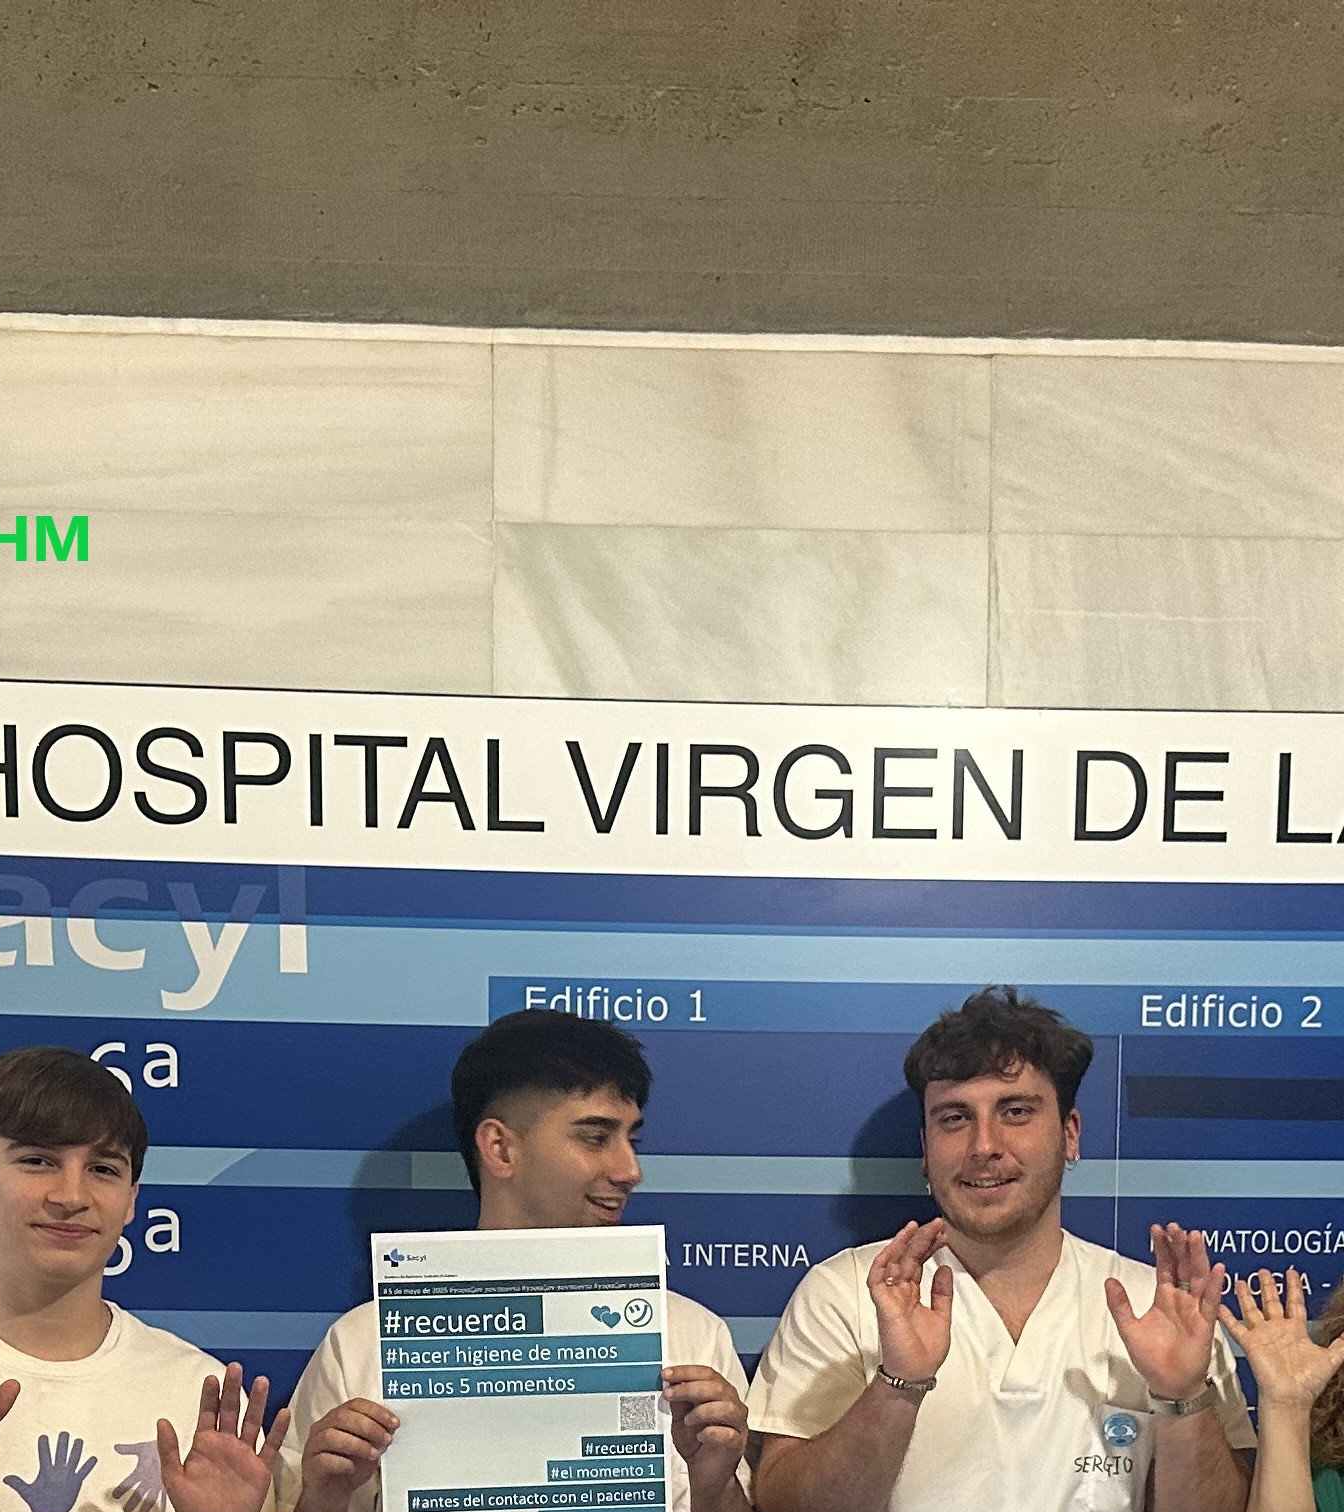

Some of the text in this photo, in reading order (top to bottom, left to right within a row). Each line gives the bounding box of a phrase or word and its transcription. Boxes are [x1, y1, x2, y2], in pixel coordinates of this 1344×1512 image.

[566, 737, 1025, 842] VIRGEN
[1073, 749, 1229, 844] DE
[525, 986, 707, 1021] Edificio 1
[1140, 993, 1322, 1028] Edificio 2
[683, 1244, 810, 1267] INTERNA
[384, 1307, 526, 1334] #recuerda
[386, 1344, 618, 1366] #hacer higiene de manos
[387, 1376, 575, 1396] #en los momentos
[585, 1440, 656, 1455] #recuerda
[551, 1464, 643, 1479] #el momento
[1074, 1455, 1133, 1477] SERGIO
[412, 1489, 655, 1508] #antes del contacto con paciente
